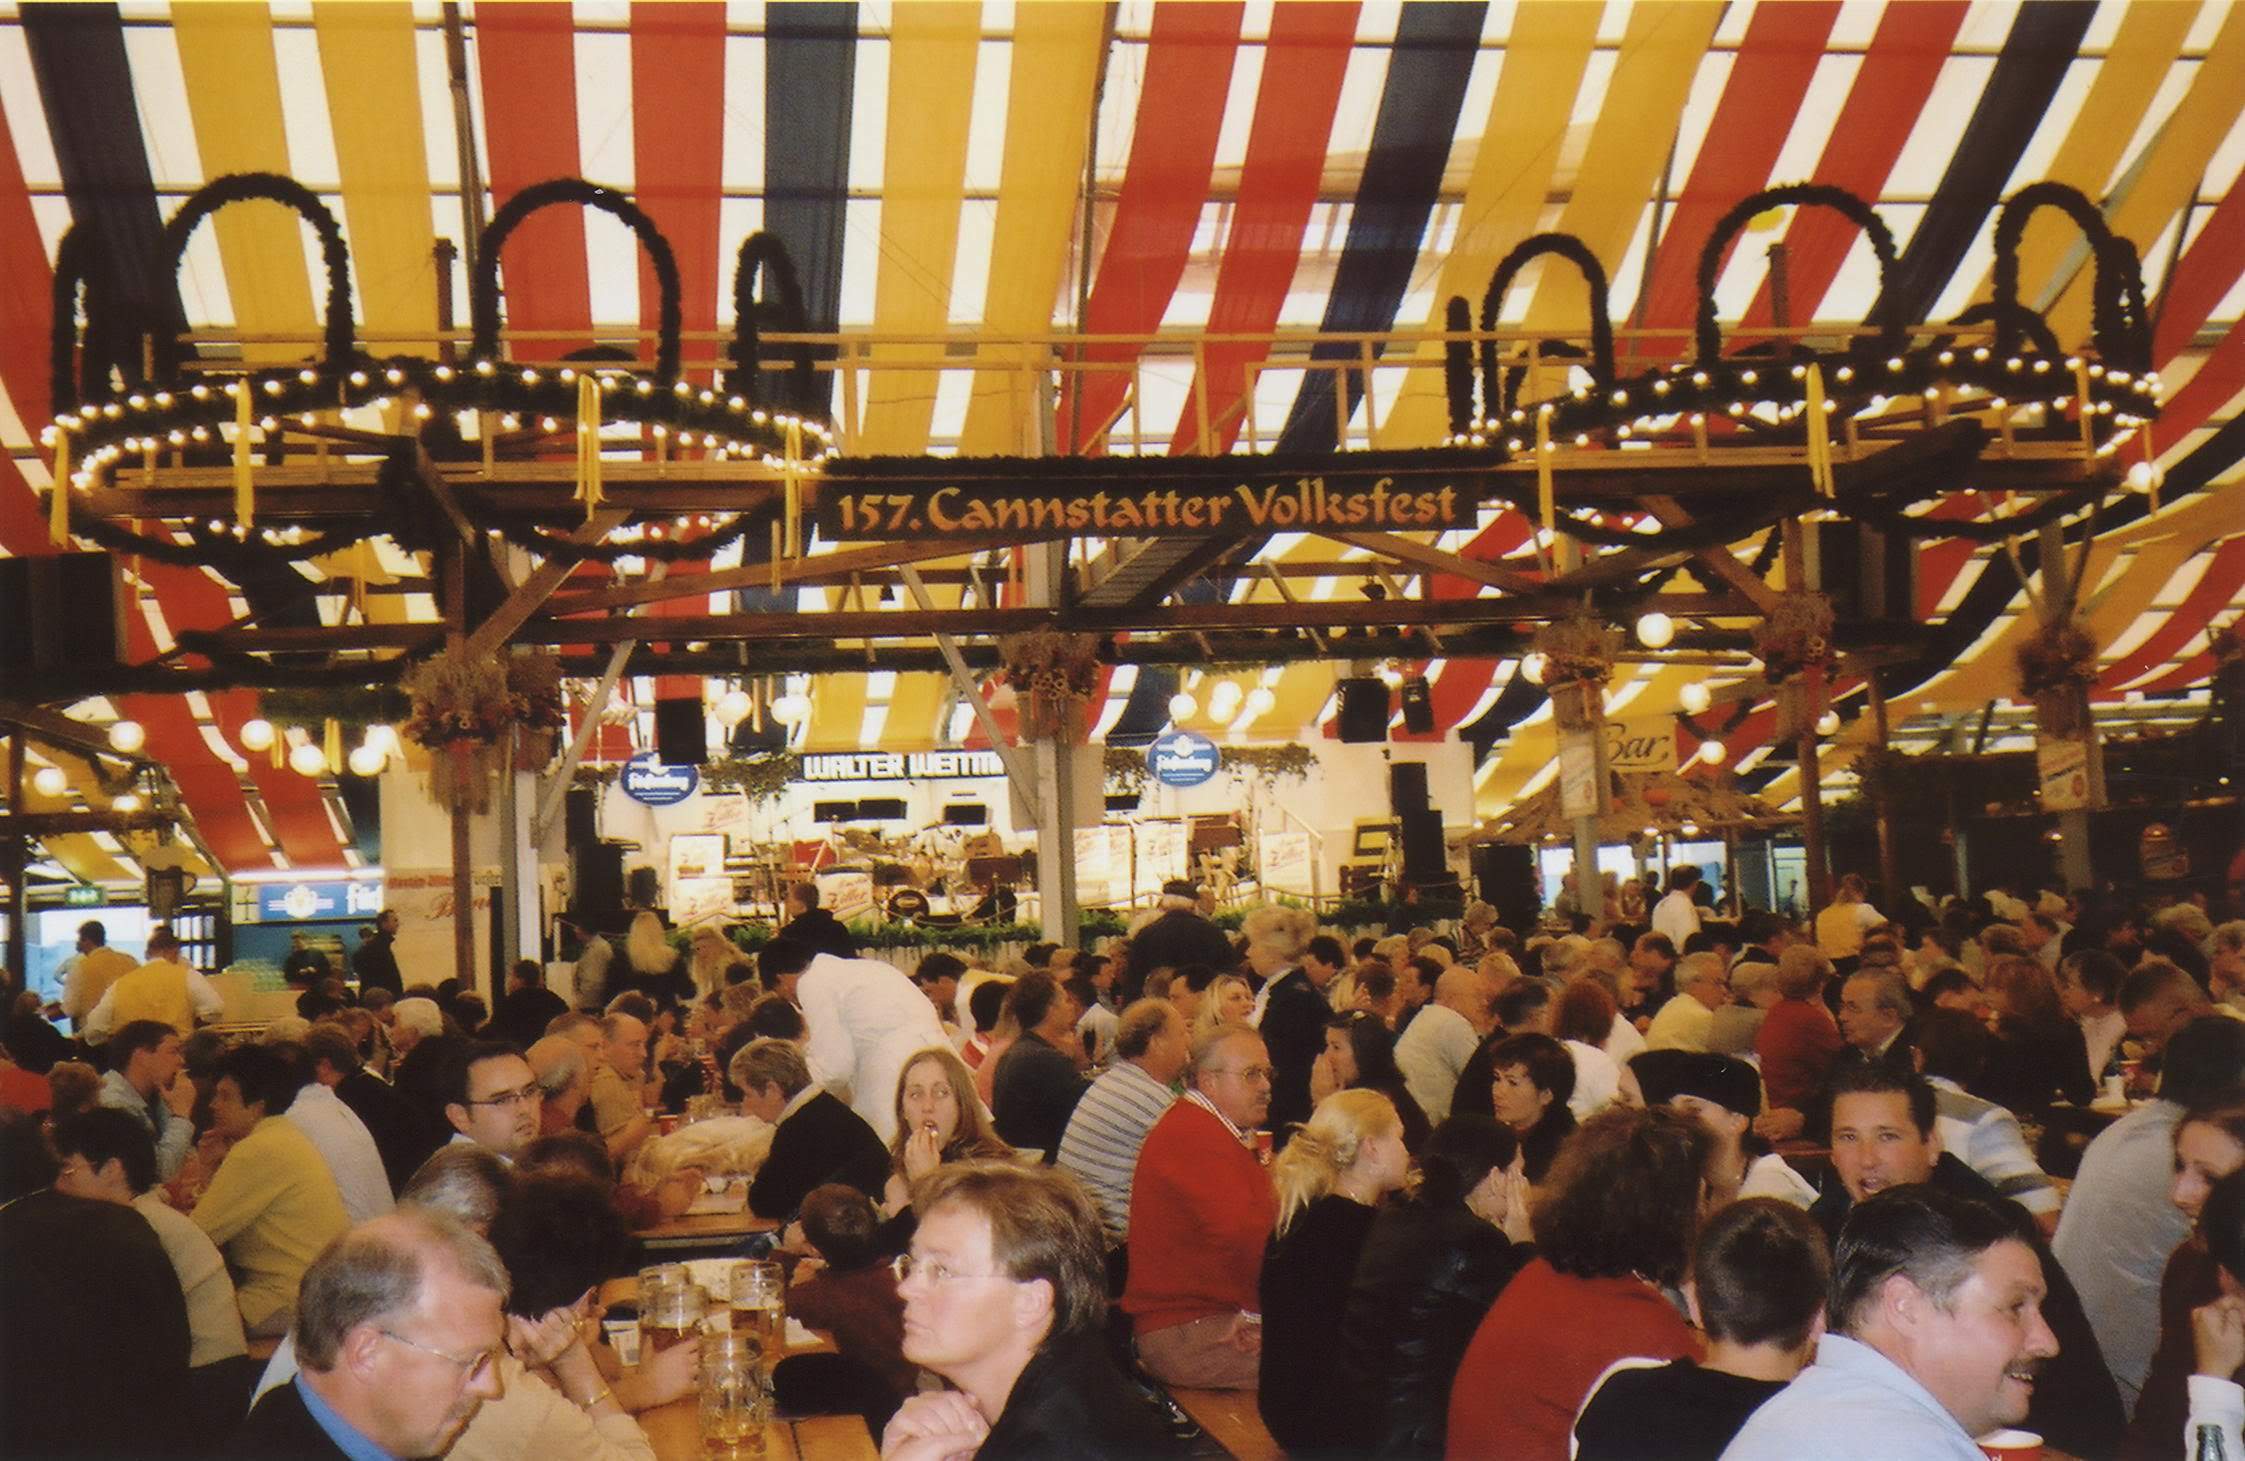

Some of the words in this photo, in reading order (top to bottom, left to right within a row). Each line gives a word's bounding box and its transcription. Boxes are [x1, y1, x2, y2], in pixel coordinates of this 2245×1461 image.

[838, 493, 923, 532] 157.
[927, 487, 1232, 531] Cannstatter
[1234, 477, 1457, 525] Volksfest
[804, 753, 904, 779] WALTER
